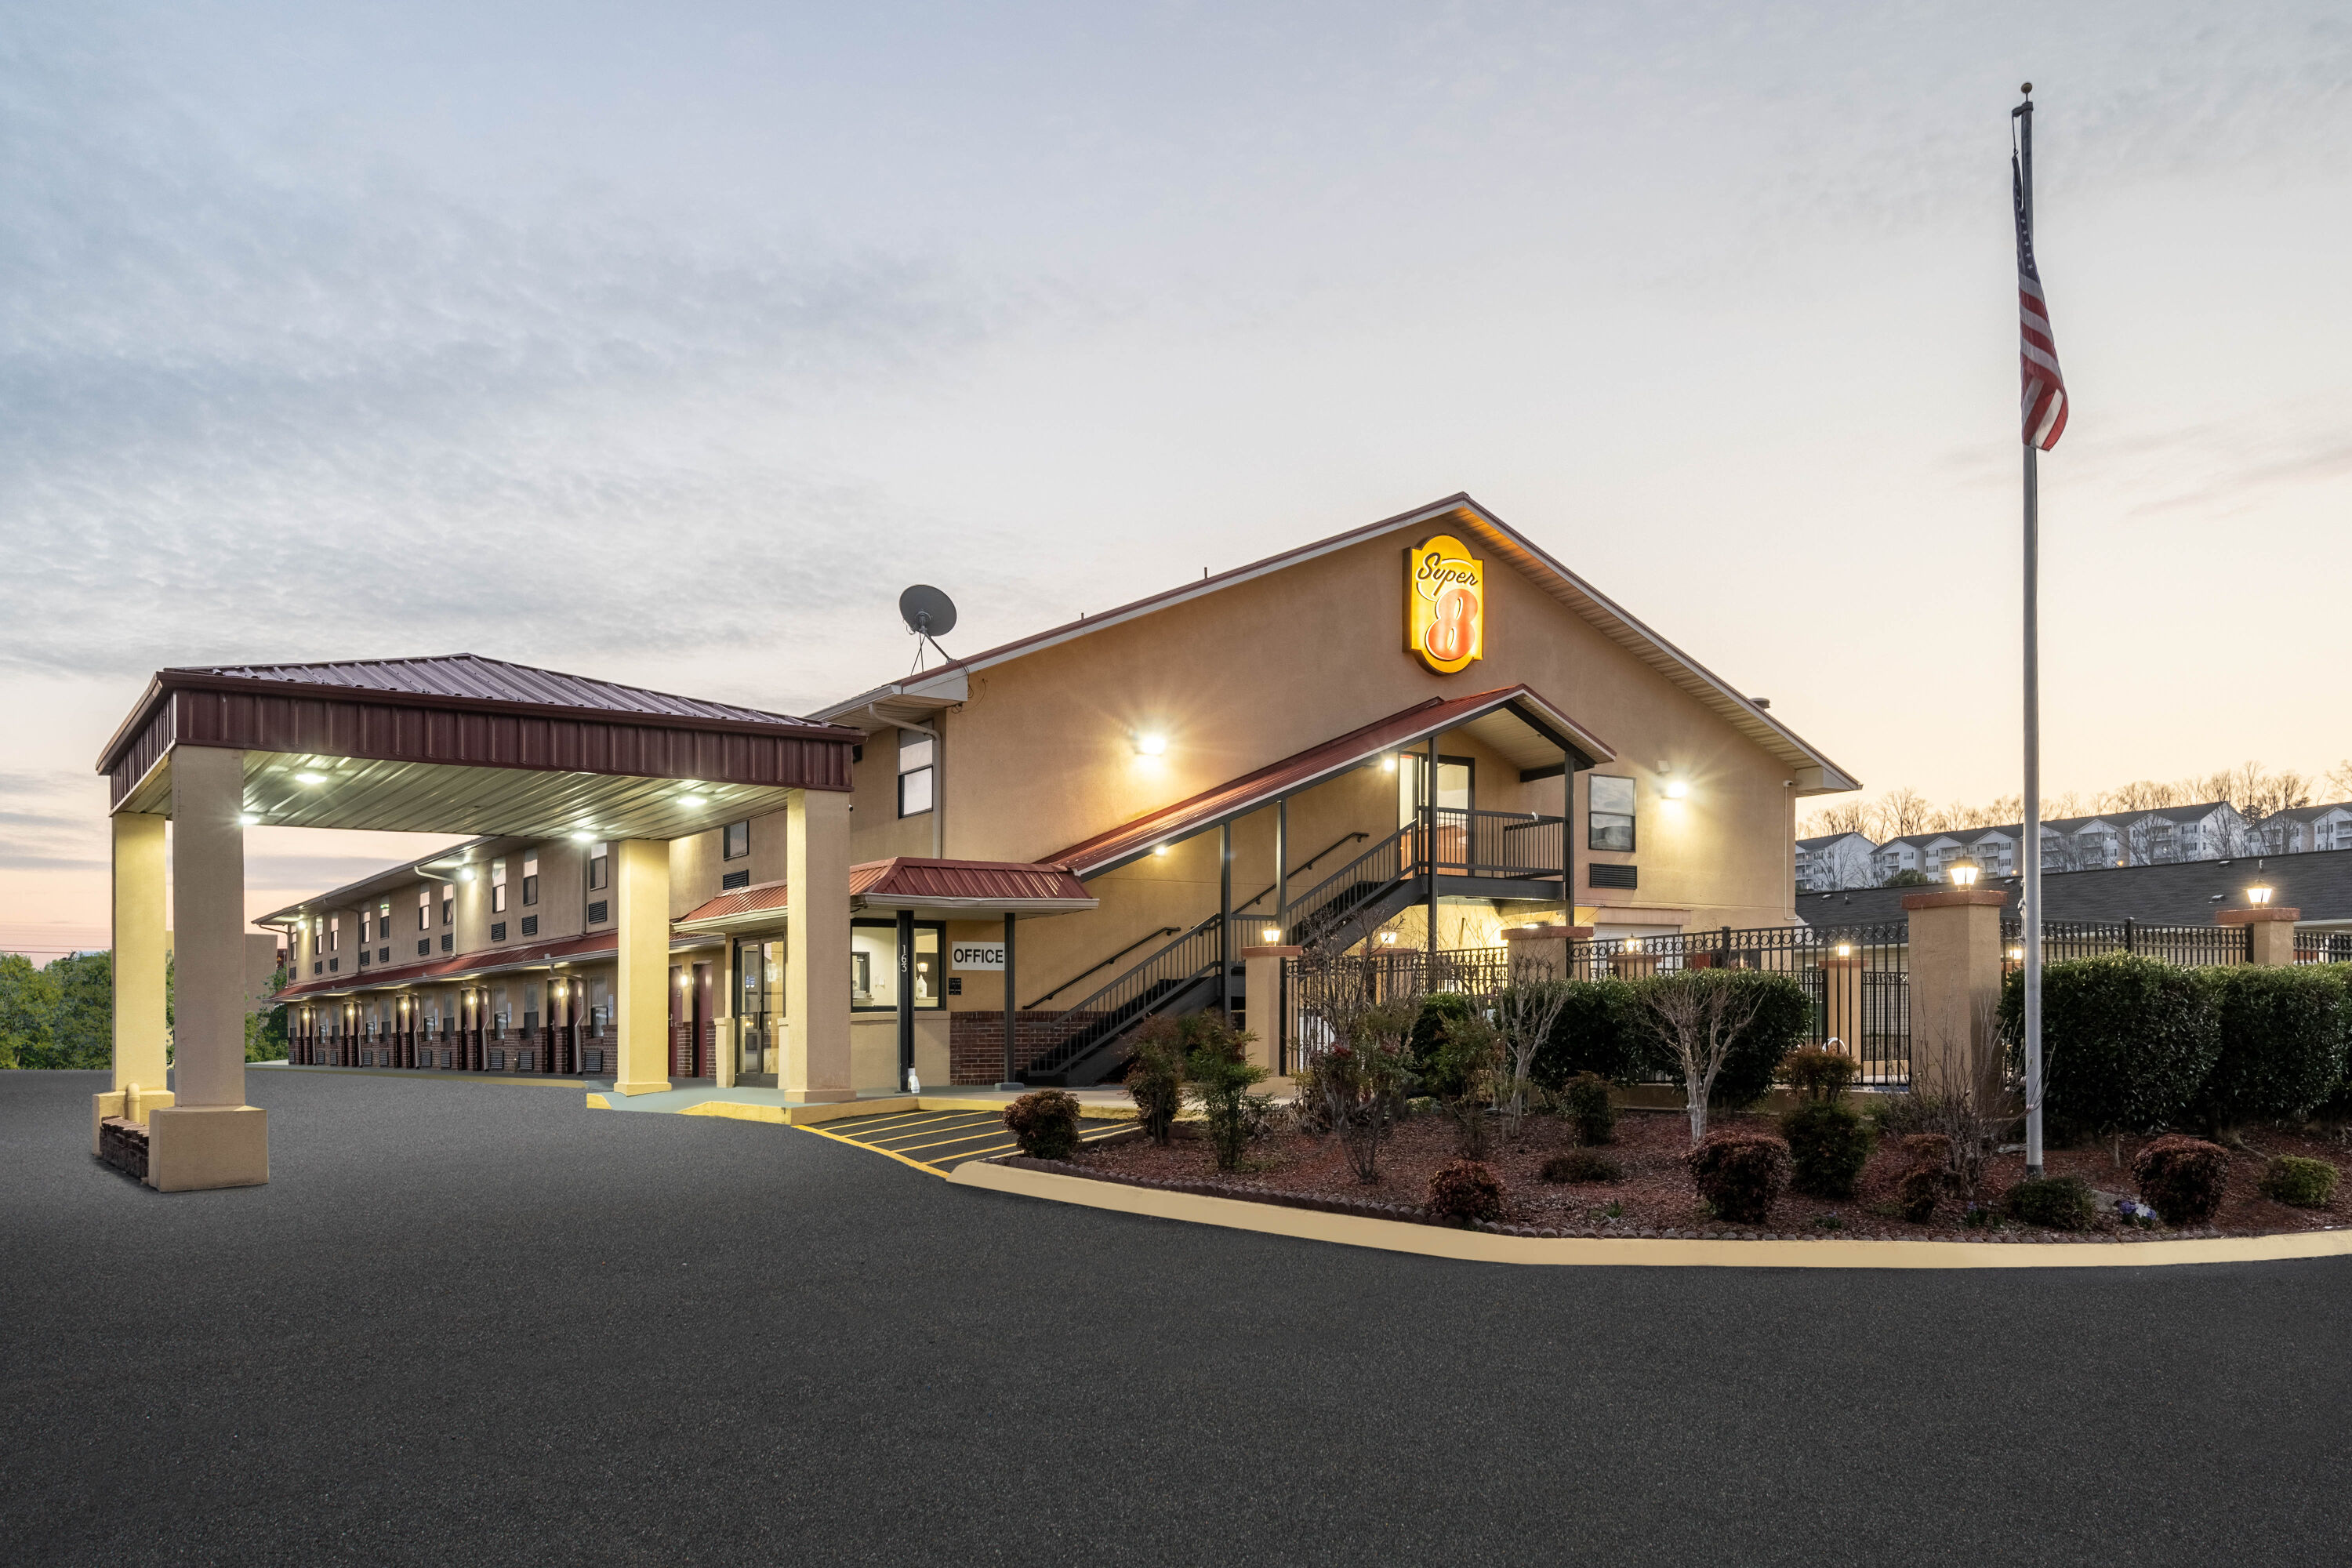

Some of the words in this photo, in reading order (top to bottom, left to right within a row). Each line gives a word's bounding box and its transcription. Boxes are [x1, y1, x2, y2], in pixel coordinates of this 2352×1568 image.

[1417, 552, 1478, 597] Super
[1425, 588, 1479, 662] 8
[953, 948, 1004, 964] OFFICE
